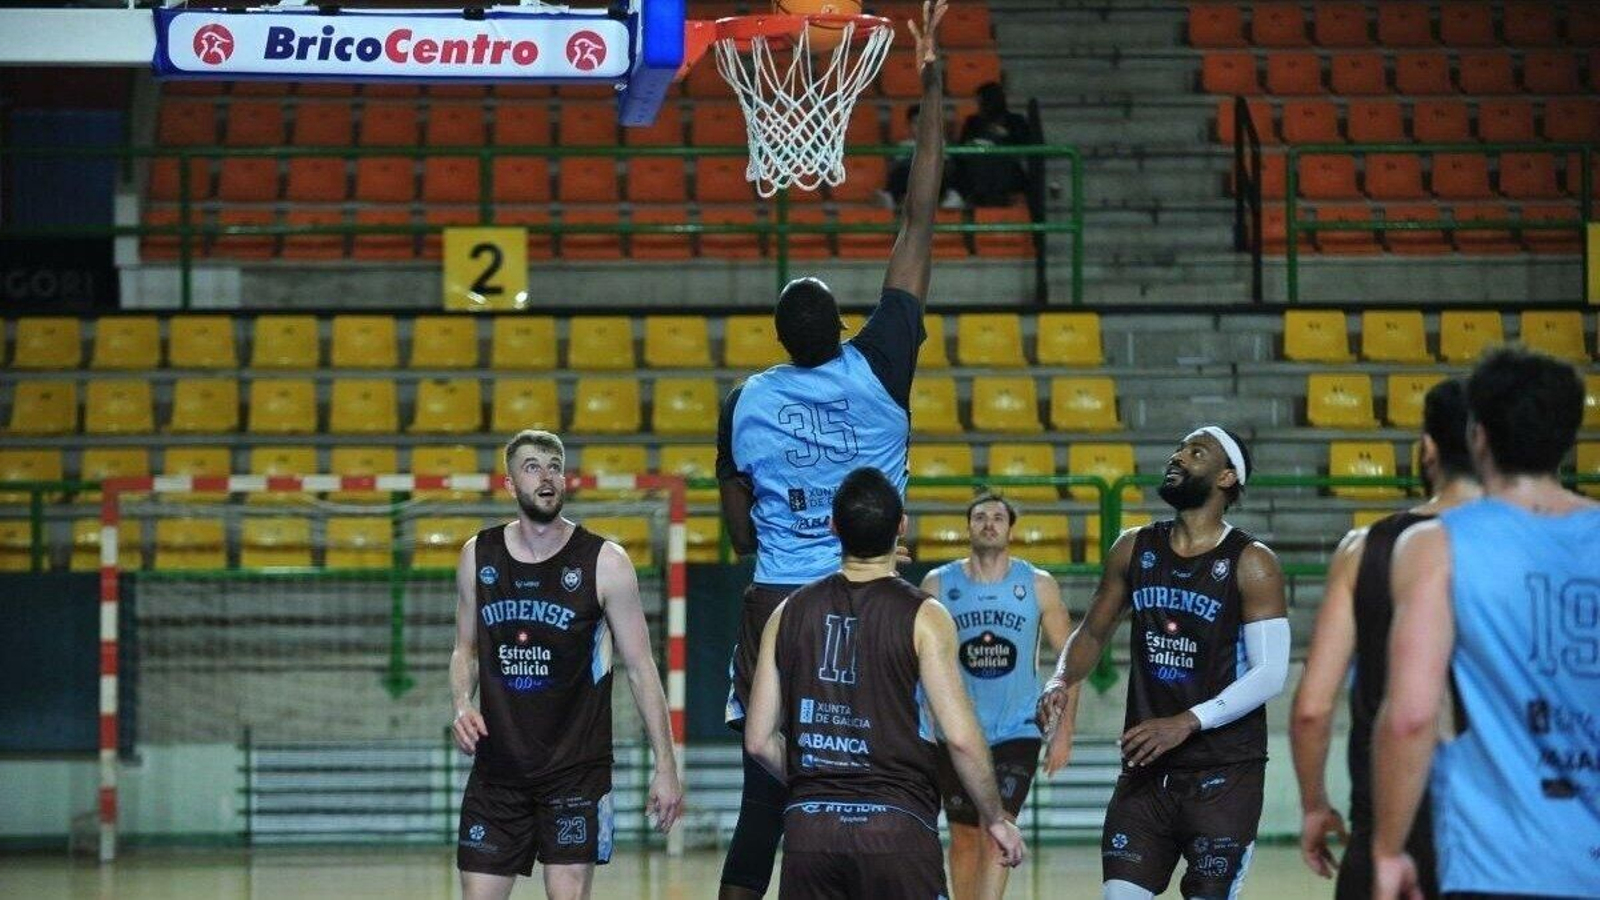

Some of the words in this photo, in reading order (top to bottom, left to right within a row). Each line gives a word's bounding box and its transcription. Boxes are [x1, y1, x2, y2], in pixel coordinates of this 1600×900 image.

[264, 25, 539, 66] BricoCentro
[468, 242, 504, 296] 2
[778, 398, 859, 468] 35
[482, 600, 576, 630] OURENSE
[1133, 586, 1222, 622] OURENSE
[1526, 571, 1600, 679] 19
[498, 644, 551, 660] Estrella
[819, 614, 857, 684] 11
[967, 644, 1010, 656] Estrella
[1146, 631, 1197, 653] Estrella
[501, 660, 549, 675] Galicia
[968, 656, 1008, 668] Galicia
[1148, 647, 1194, 669] Galicia
[817, 702, 852, 715] XUNTA
[815, 713, 830, 724] DE
[832, 715, 871, 730] GALICIA
[799, 732, 869, 754] ABANCA
[557, 816, 587, 844] 23
